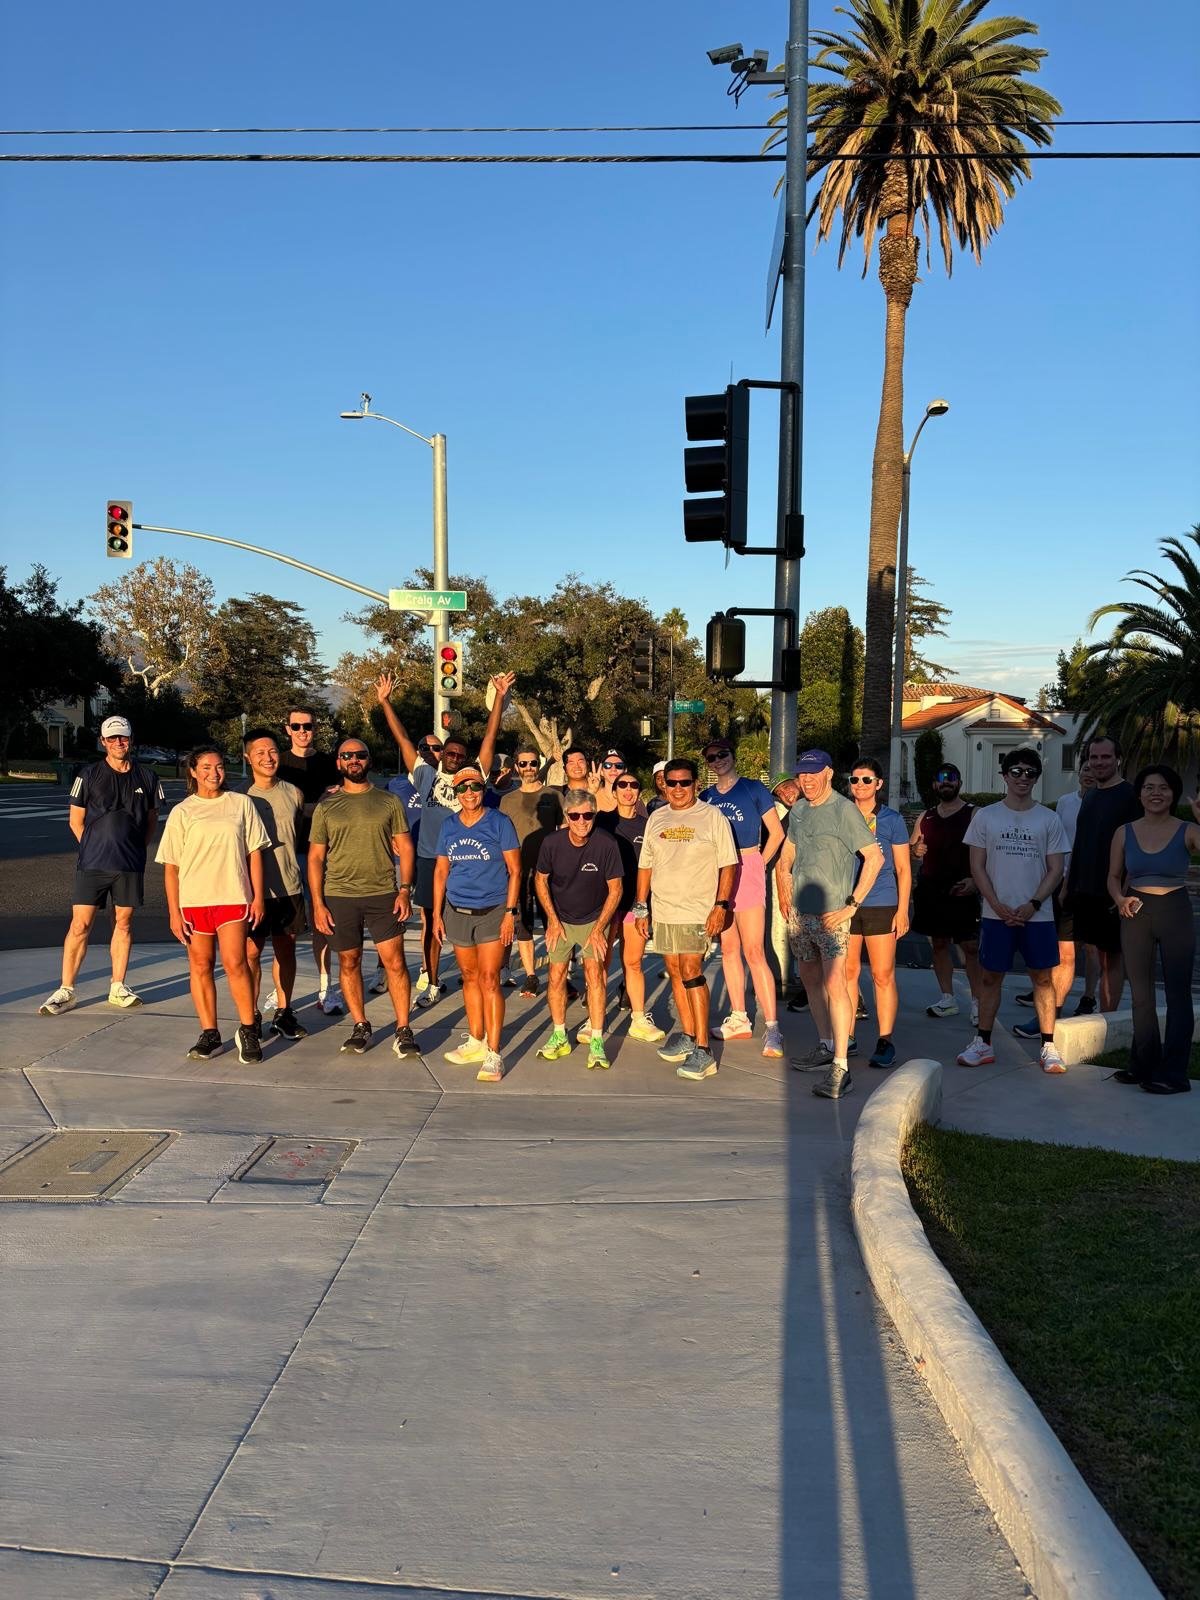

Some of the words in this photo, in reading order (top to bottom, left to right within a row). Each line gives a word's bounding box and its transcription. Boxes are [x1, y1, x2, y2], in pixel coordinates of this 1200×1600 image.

[437, 594, 451, 605] Av
[407, 792, 421, 809] RUN
[735, 809, 744, 822] US
[459, 838, 482, 850] WITH
[480, 847, 490, 861] US
